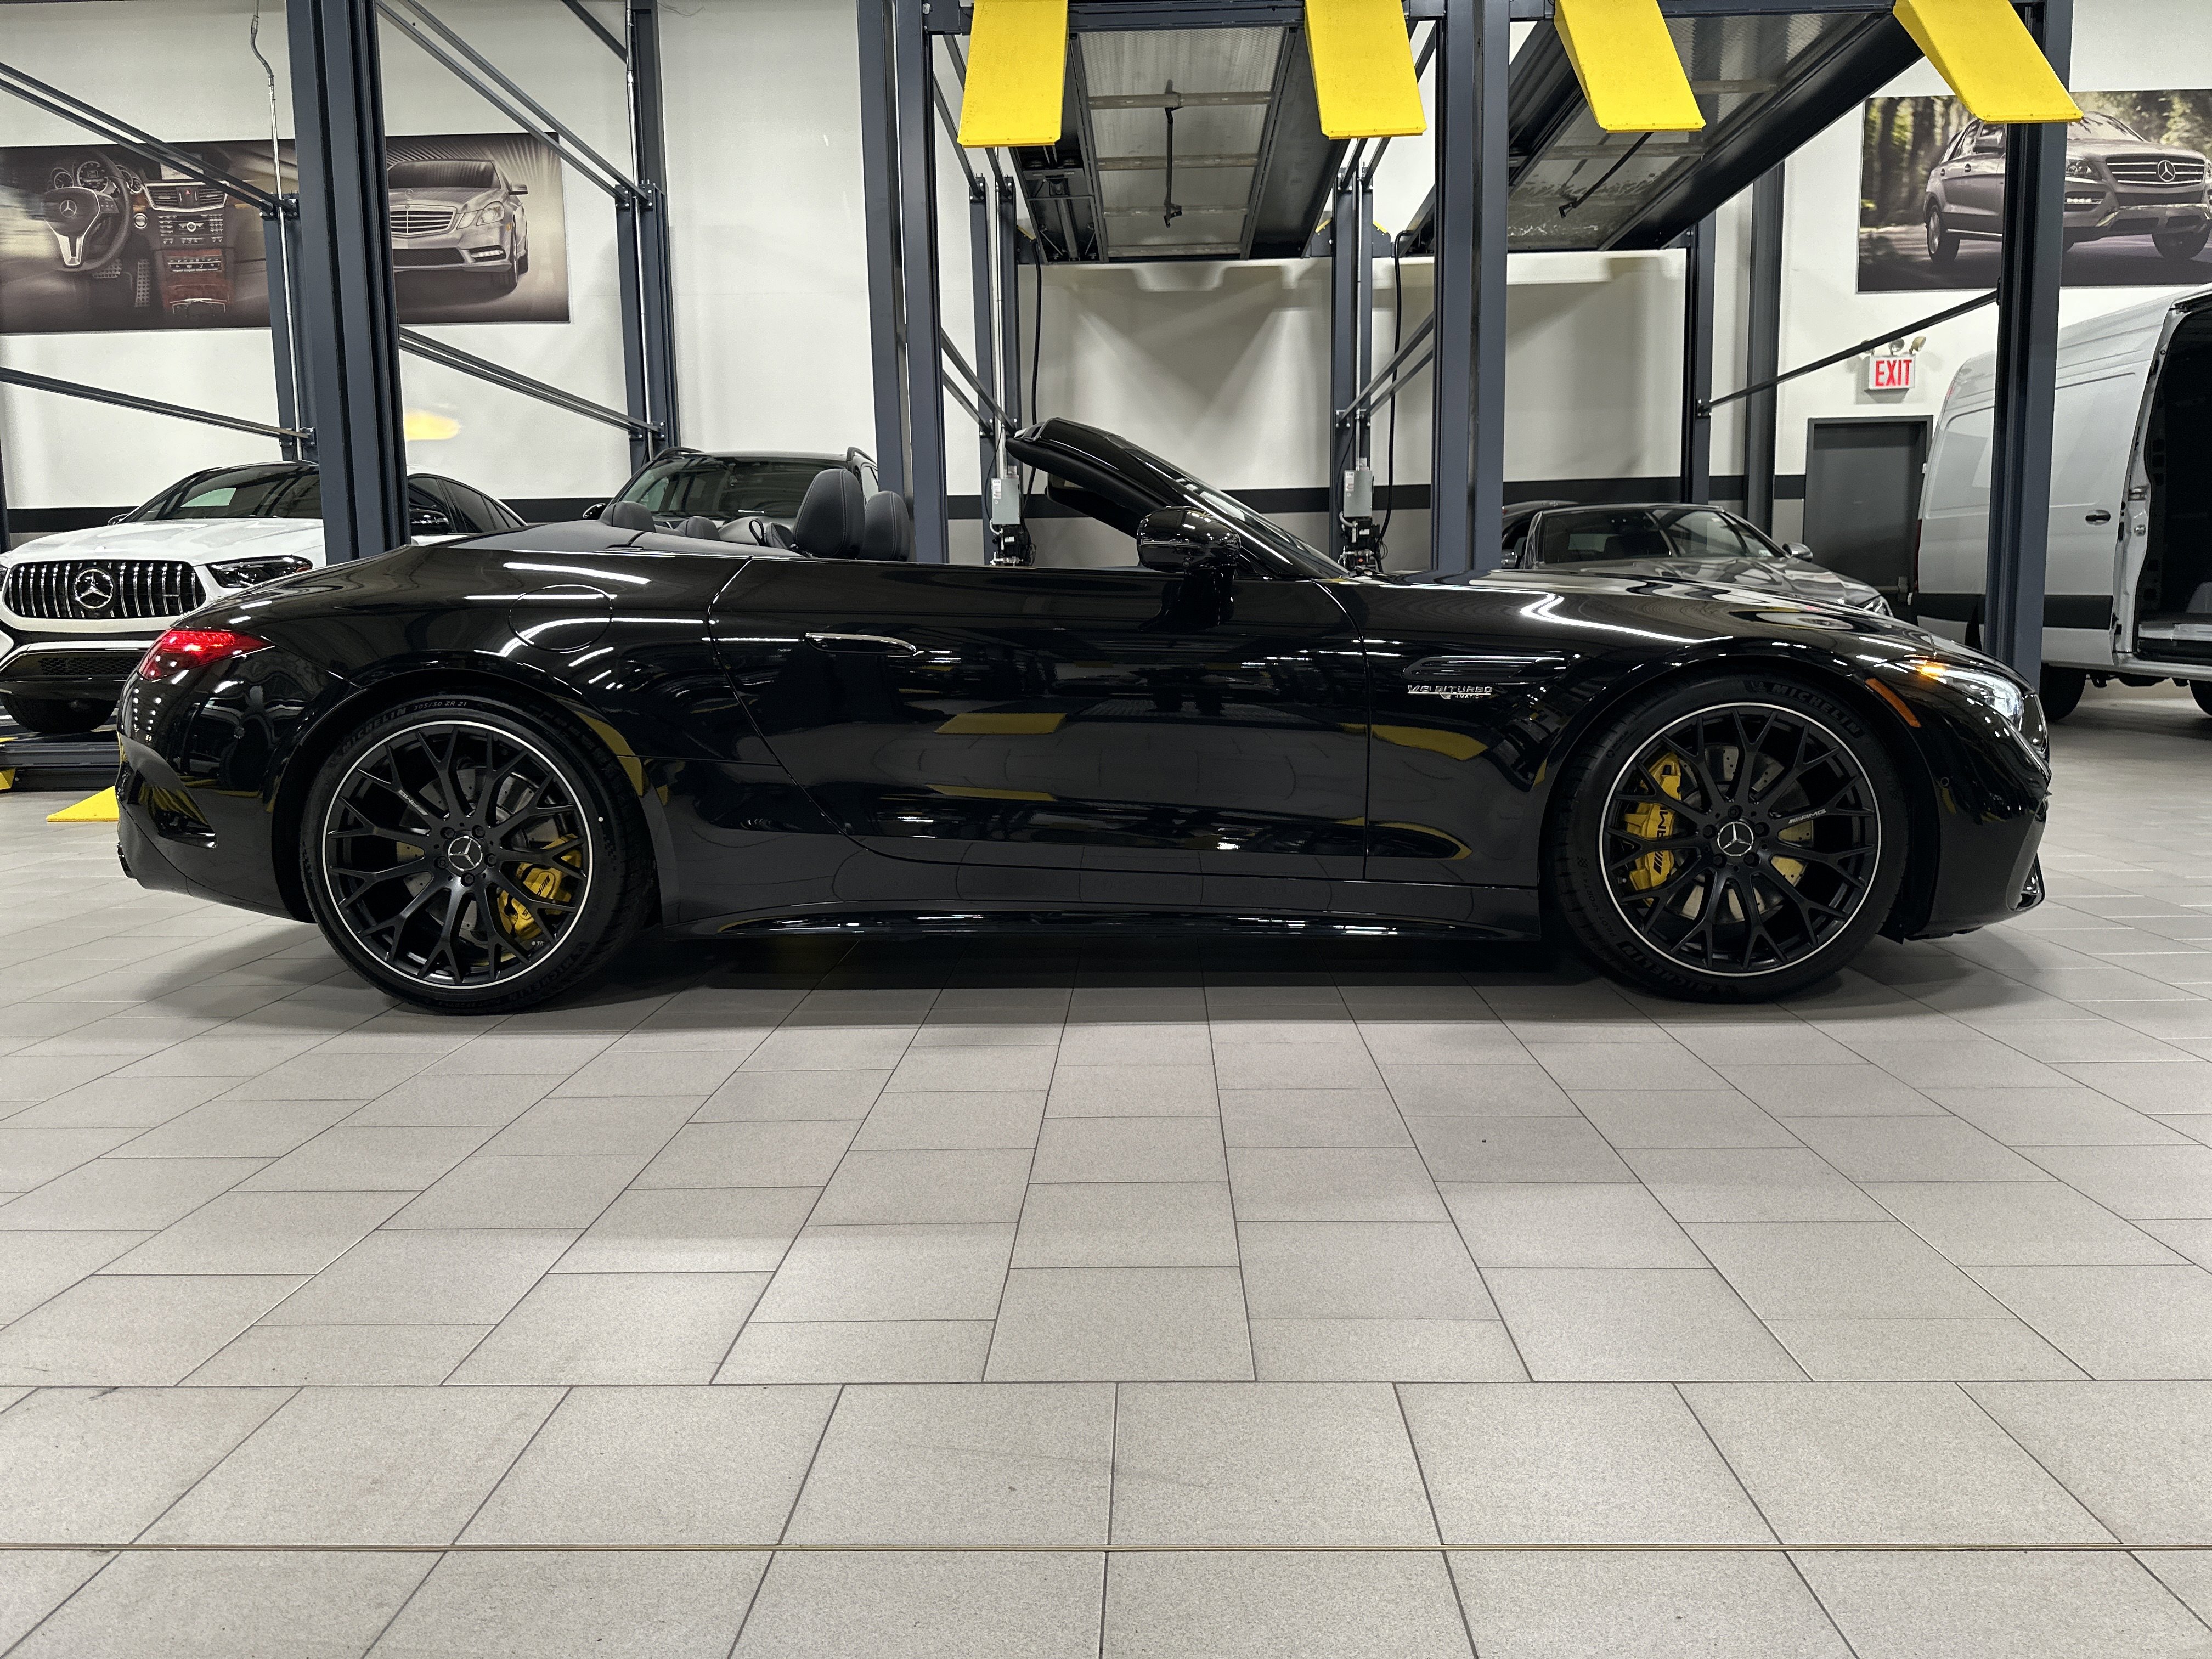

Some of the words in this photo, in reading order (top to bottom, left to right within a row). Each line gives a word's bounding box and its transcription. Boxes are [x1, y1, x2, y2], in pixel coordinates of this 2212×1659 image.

[1875, 359, 1912, 386] EXIT
[1772, 683, 1861, 735] MICHELIN
[342, 707, 408, 753] MICHELIN
[413, 701, 443, 710] 305/30
[398, 789, 421, 809] AMG
[1798, 808, 1826, 821] AMG
